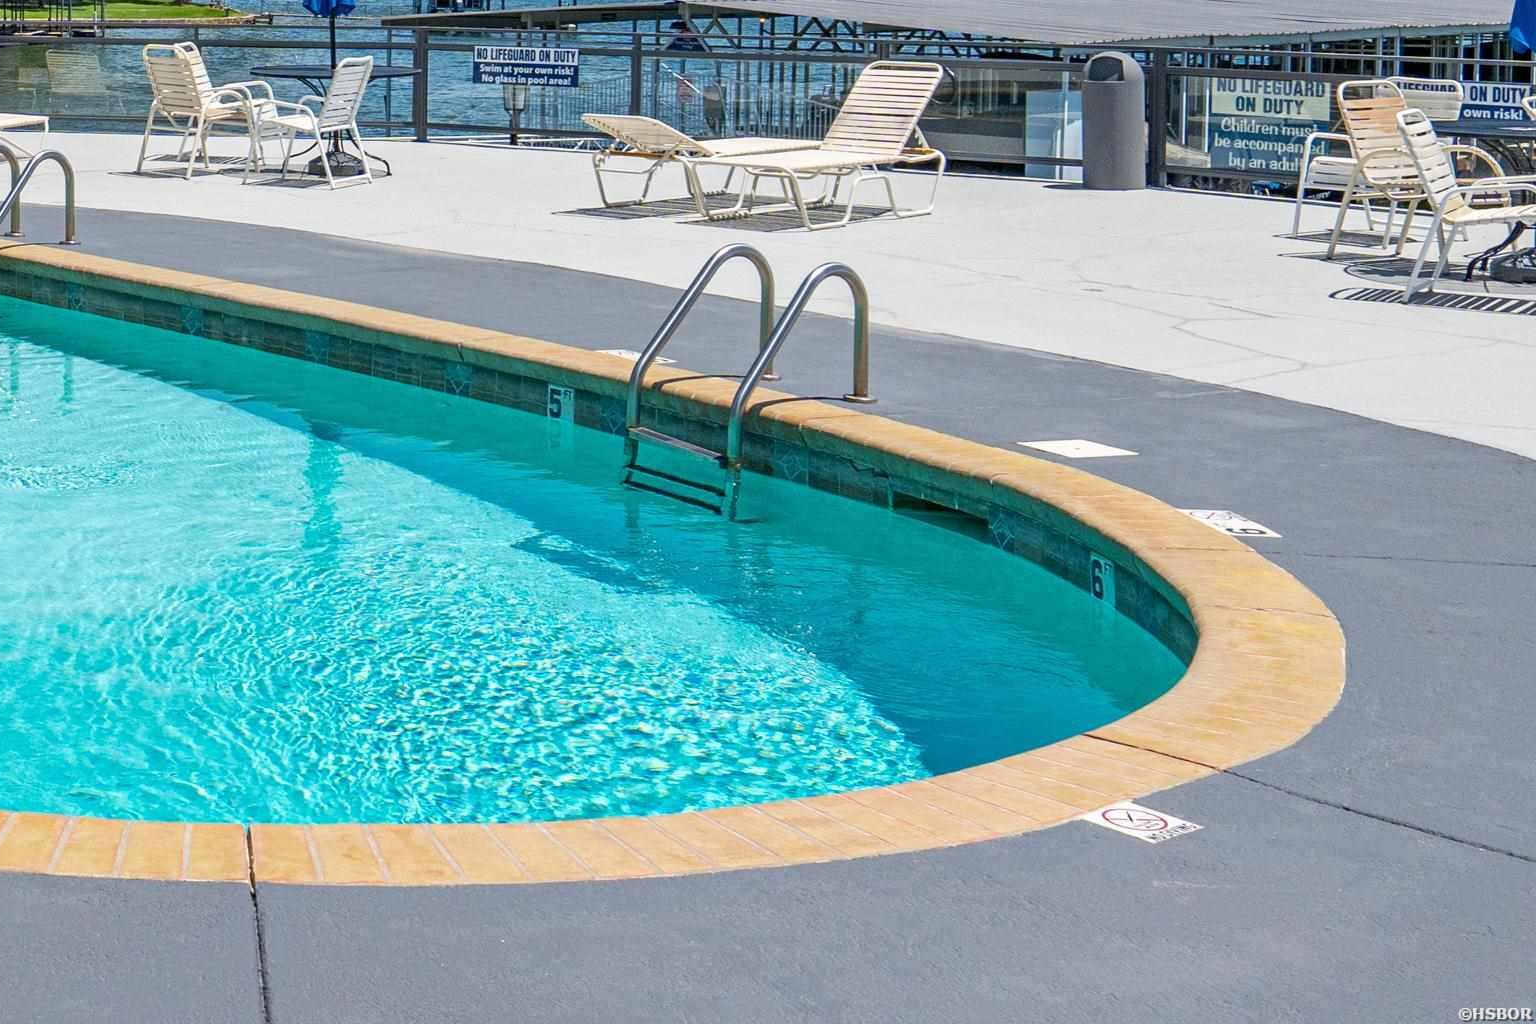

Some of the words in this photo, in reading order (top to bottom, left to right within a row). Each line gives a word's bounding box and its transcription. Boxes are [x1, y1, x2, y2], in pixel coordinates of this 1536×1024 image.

[477, 48, 488, 60] NO
[491, 48, 536, 62] LIFEGUARD
[539, 49, 551, 62] ON
[554, 50, 577, 63] DUTY
[480, 64, 502, 73] Swim
[504, 65, 512, 74] at
[513, 67, 532, 75] your
[535, 67, 552, 75] own
[555, 66, 574, 76] risk!
[482, 74, 493, 83] No
[495, 75, 516, 85] glass
[517, 75, 526, 84] in
[528, 76, 548, 86] pool
[549, 77, 572, 86] area!
[1217, 78, 1237, 93] NO
[1242, 79, 1325, 97] LIFEGUARD
[1470, 86, 1487, 102] ON
[1493, 87, 1527, 104] DUTY
[1236, 96, 1256, 112] ON
[1264, 98, 1304, 115] DUTY
[1464, 110, 1491, 120] own
[1494, 108, 1523, 121] risk!
[1221, 117, 1279, 135] Children
[1214, 133, 1232, 148] be
[1234, 139, 1324, 155] accompaned
[1229, 152, 1245, 169] by
[1249, 158, 1266, 169] an
[1270, 157, 1299, 171] adul
[550, 388, 561, 418] 5
[1092, 559, 1104, 600] 6
